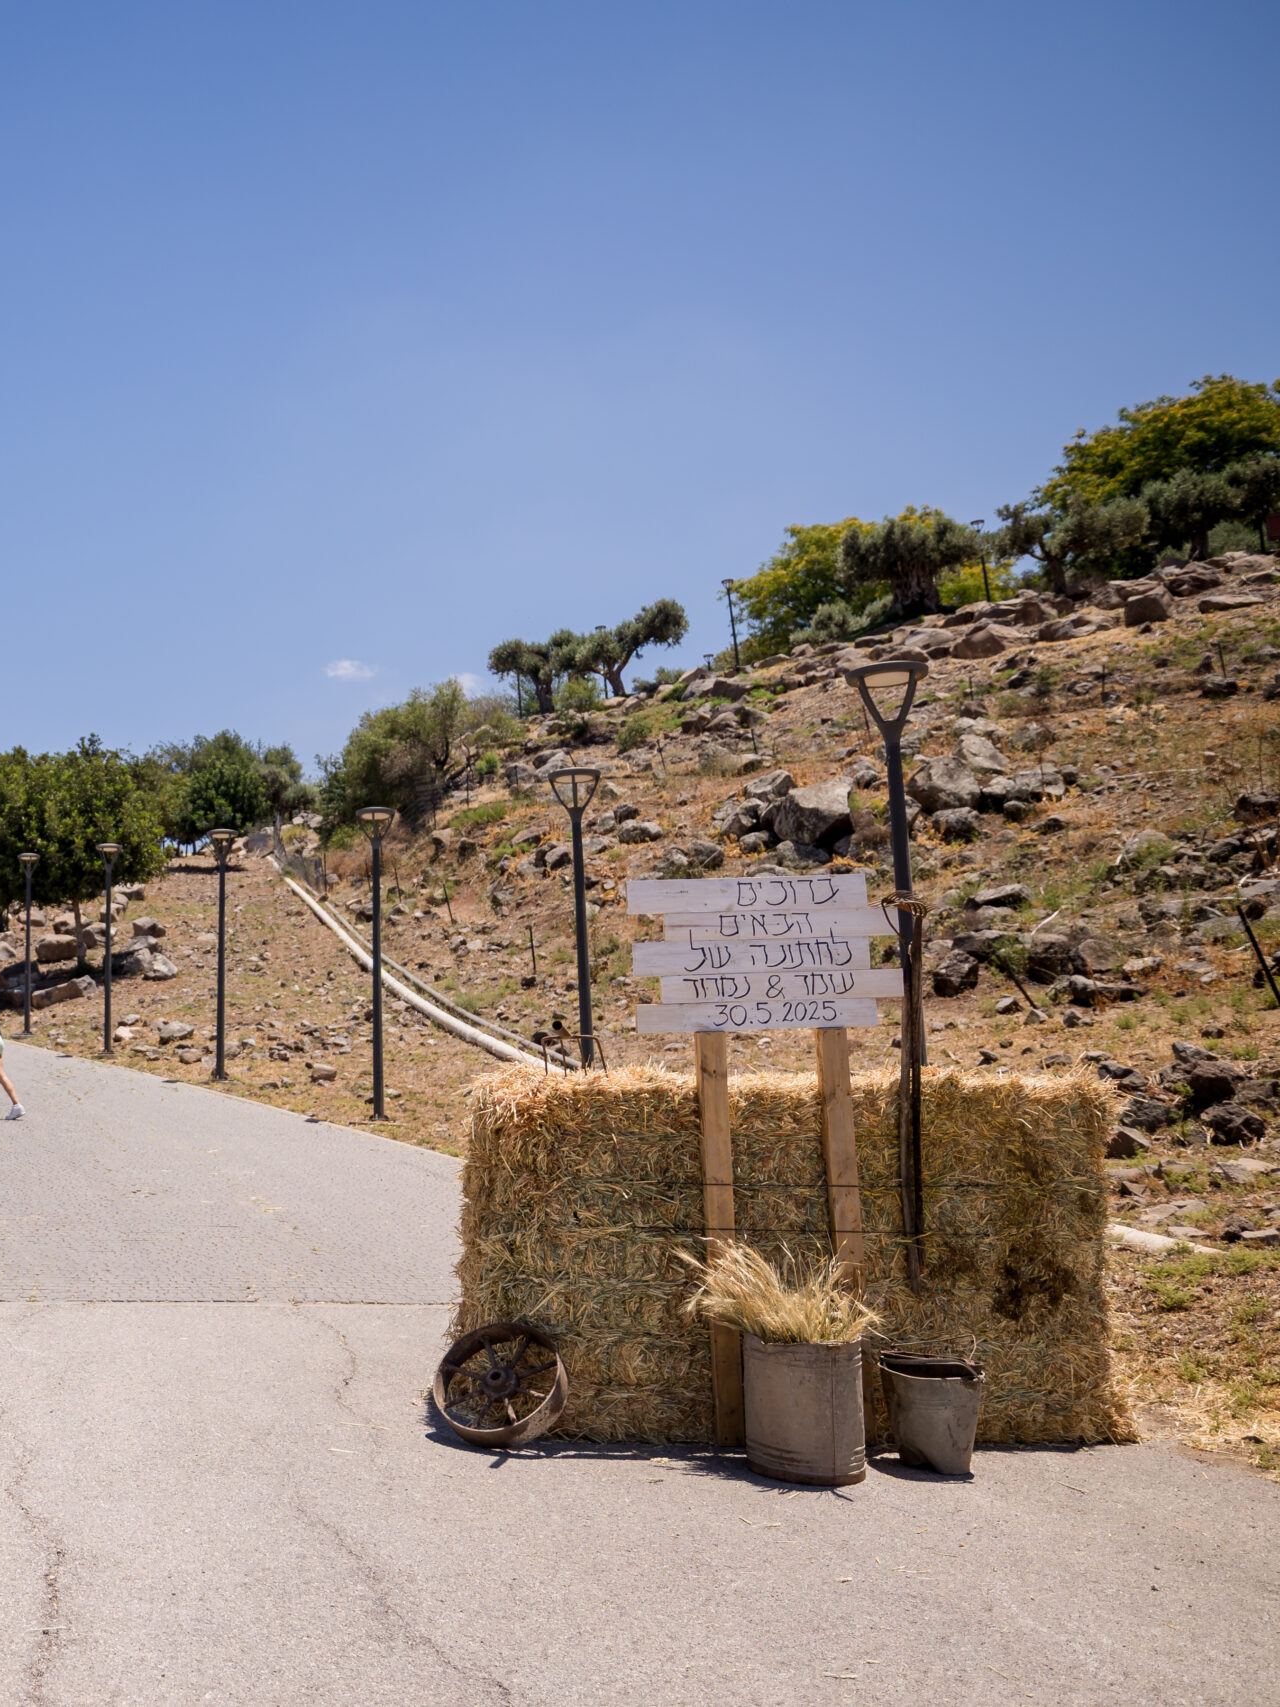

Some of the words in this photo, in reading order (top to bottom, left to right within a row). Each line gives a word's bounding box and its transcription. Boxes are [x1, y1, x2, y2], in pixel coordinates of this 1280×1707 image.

[737, 878, 840, 907] ברוכים
[718, 912, 813, 937] הבאים
[683, 929, 732, 972] של
[748, 927, 853, 970] לחתונה
[682, 975, 751, 999] נמרוד
[765, 974, 786, 999] &
[712, 1000, 838, 1027] 30.5.2025
